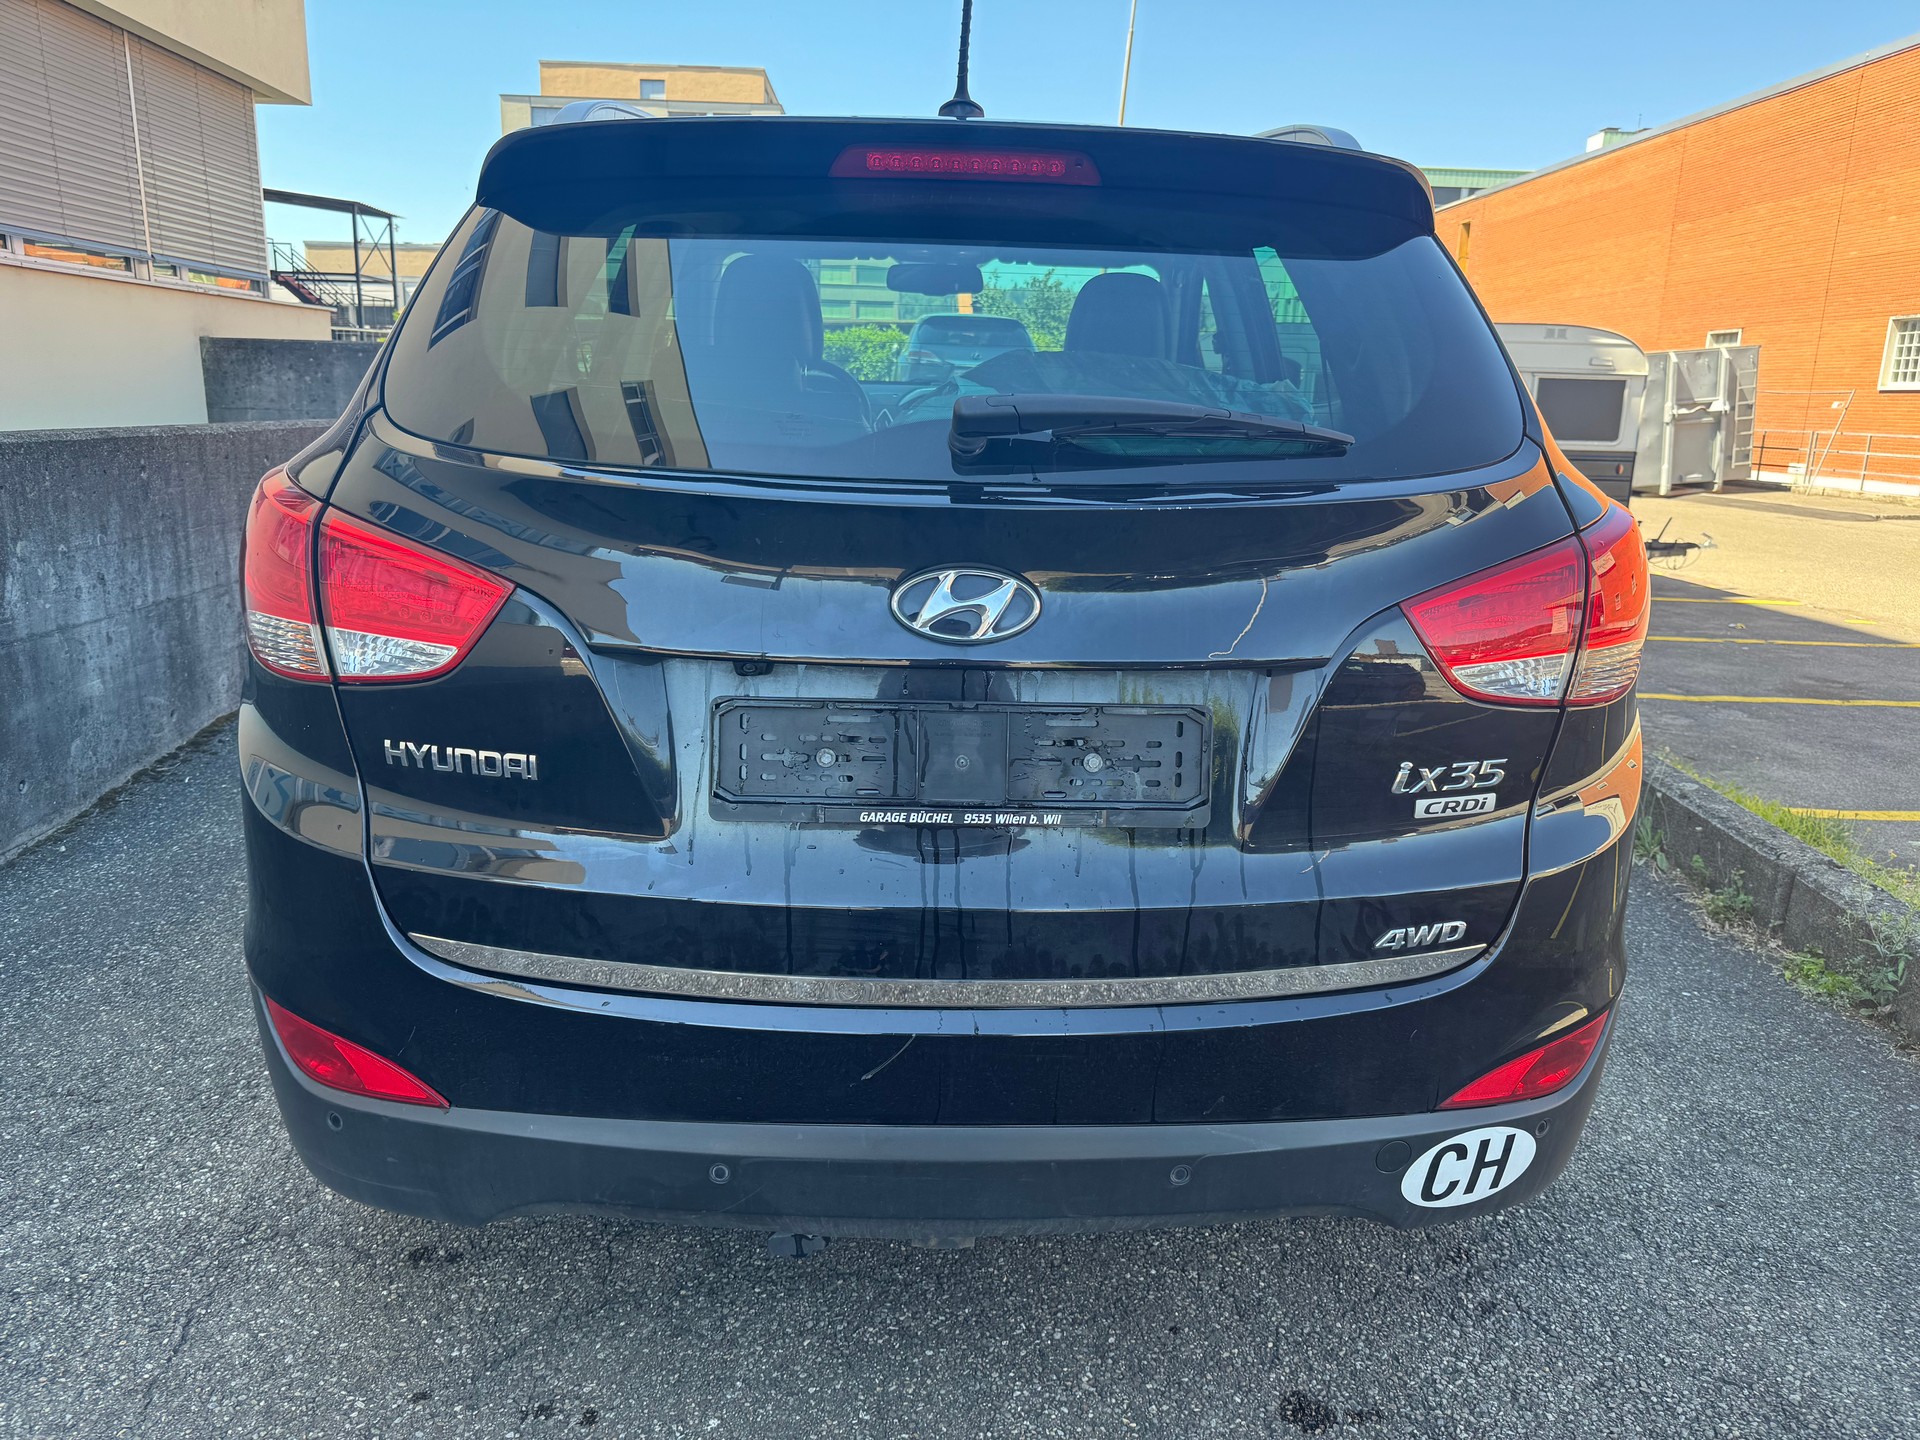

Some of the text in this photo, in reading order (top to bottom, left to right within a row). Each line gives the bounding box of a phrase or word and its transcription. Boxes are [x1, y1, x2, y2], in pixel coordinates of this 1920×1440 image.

[384, 739, 538, 780] HYUNDAI
[1391, 758, 1509, 794] ix35
[859, 811, 908, 823] GARAGE
[908, 810, 954, 824] BÜCHEL
[963, 813, 992, 824] 9535
[1029, 814, 1040, 825] b.
[1043, 814, 1062, 825] Wil
[1423, 797, 1489, 815] CRDi
[1374, 920, 1467, 950] 4WD
[1420, 1133, 1517, 1203] CH
